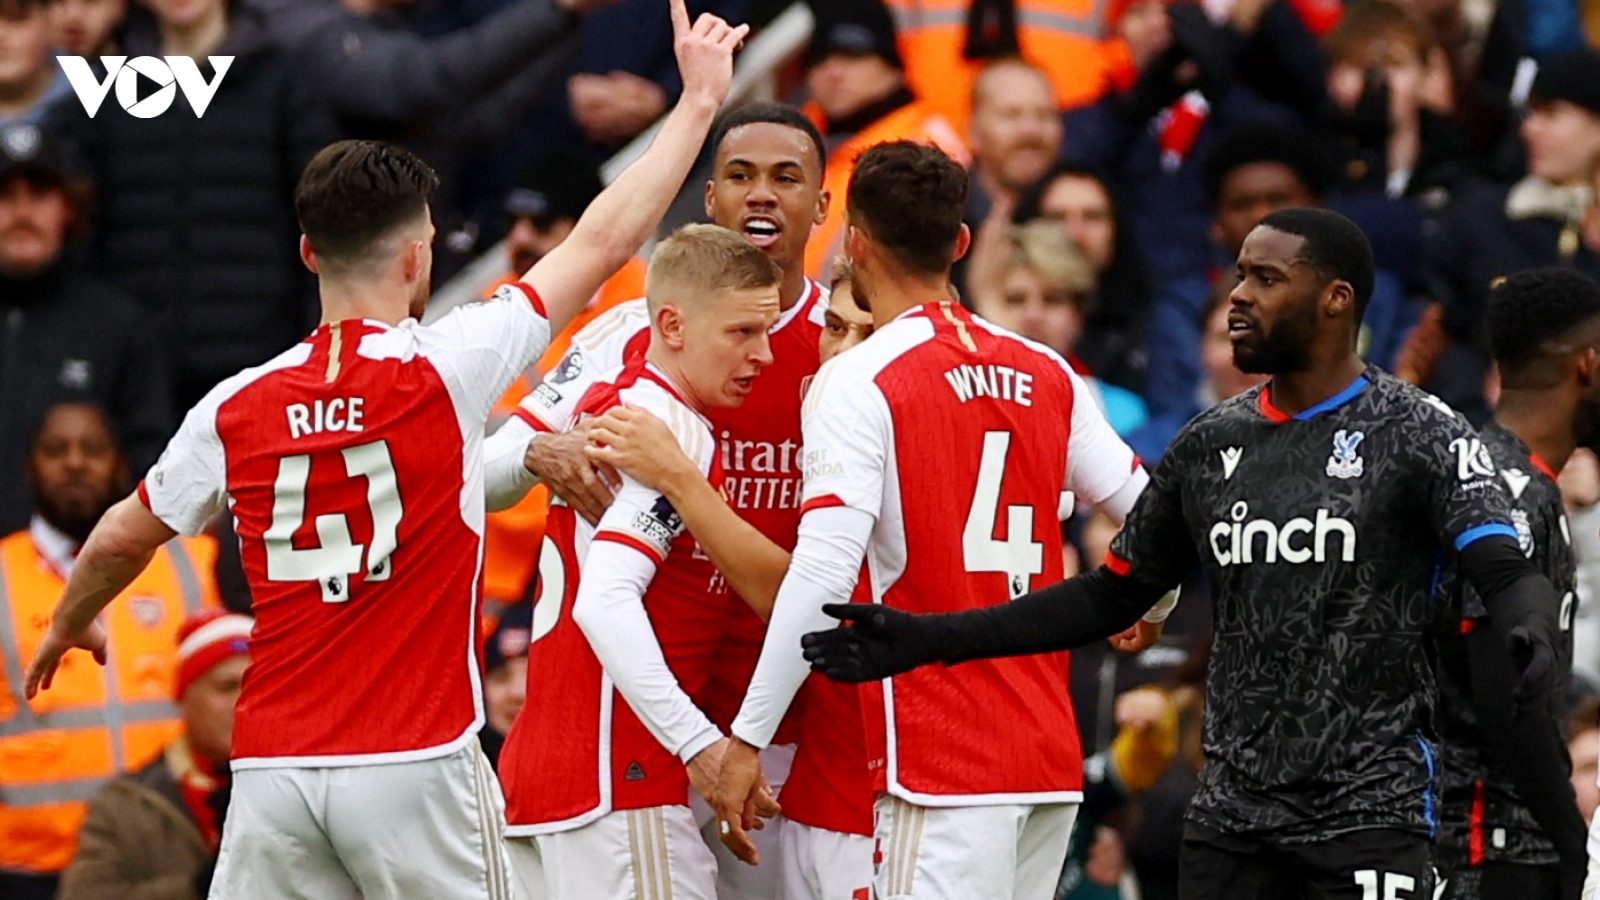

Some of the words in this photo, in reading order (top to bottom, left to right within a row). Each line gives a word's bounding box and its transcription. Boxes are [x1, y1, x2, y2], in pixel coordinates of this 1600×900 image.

[286, 397, 364, 439] RICE
[264, 439, 403, 603] 41
[962, 431, 1044, 600] 4
[1209, 500, 1356, 567] cinch
